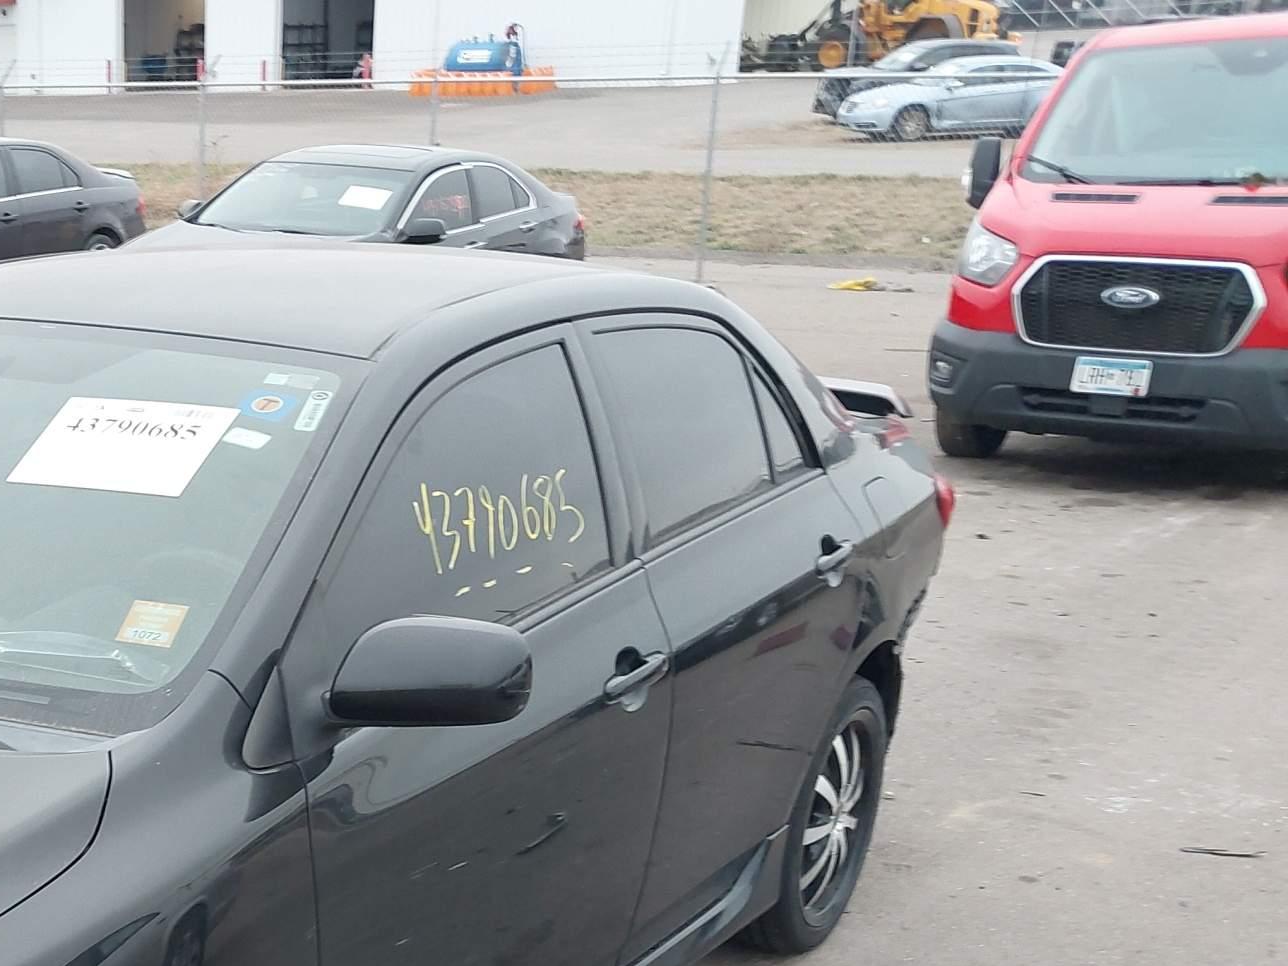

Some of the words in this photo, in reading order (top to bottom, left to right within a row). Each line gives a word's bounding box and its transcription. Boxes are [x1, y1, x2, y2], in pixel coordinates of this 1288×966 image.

[66, 417, 202, 440] 43790685
[412, 468, 585, 575] 43790685
[131, 629, 162, 641] 1072
